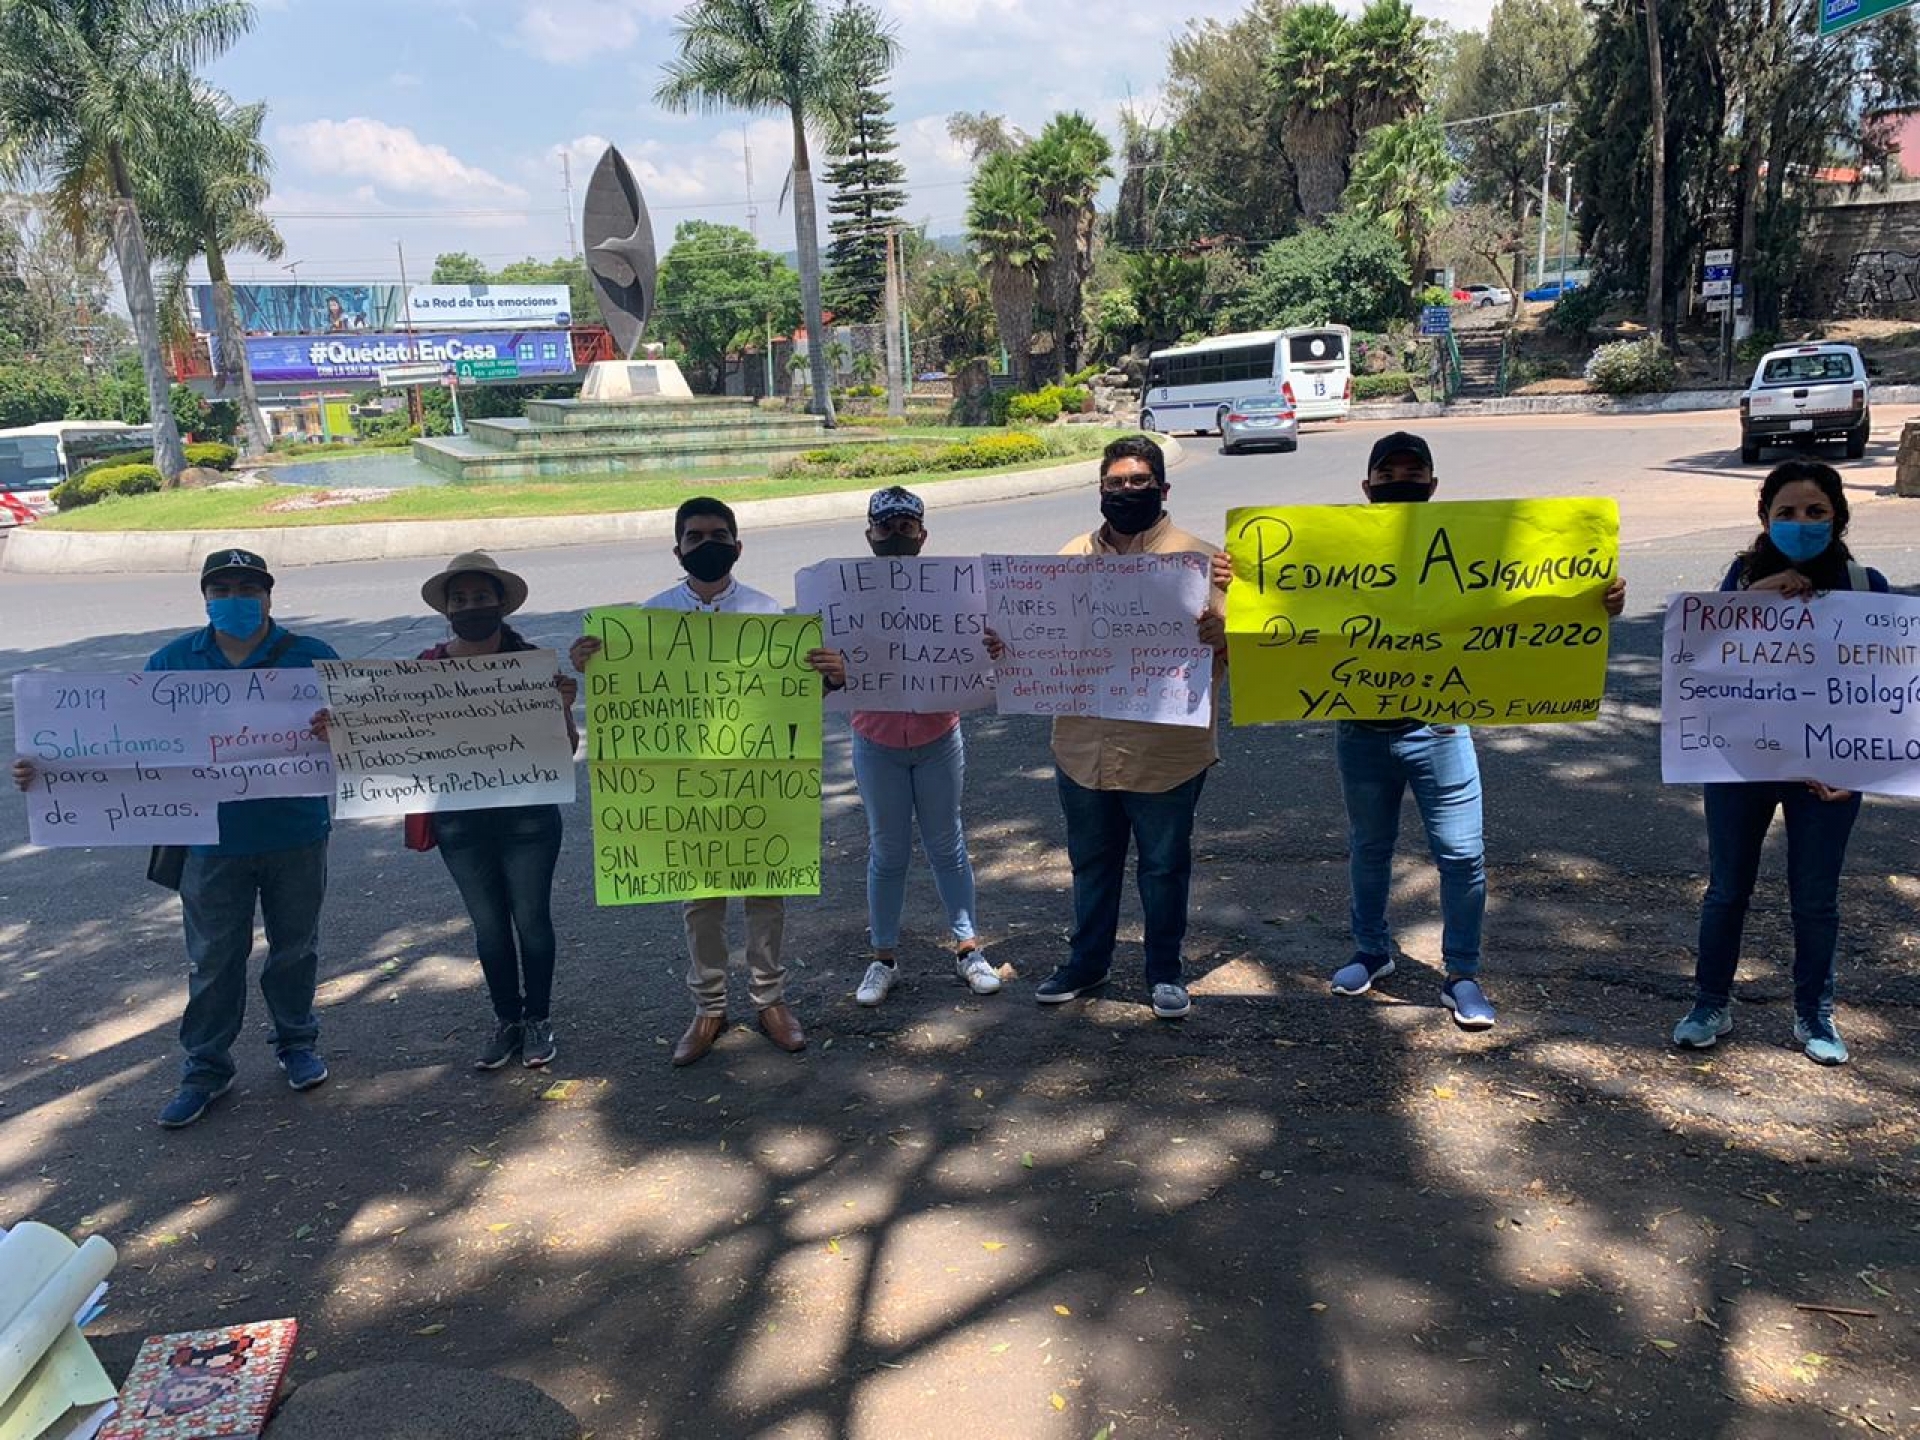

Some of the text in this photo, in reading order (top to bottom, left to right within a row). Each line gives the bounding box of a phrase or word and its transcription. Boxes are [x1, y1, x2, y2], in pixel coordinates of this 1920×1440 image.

[414, 297, 558, 308] La Red de tus emociones
[1313, 383, 1326, 397] 13
[1238, 515, 1613, 595] PEDIMOS ASIGNACIÓN
[989, 576, 1042, 591] sultado
[1072, 592, 1150, 617] MANUEL
[1682, 596, 1815, 633] PRÓRROGA
[1010, 617, 1186, 641] LÓPEZ OBRADOR
[1257, 615, 1321, 648] DE
[1463, 622, 1603, 652] 2019-2020
[889, 642, 974, 665] PLAZAS
[1003, 645, 1112, 660] Necesitamos
[1670, 639, 1696, 664] de
[1721, 642, 1816, 665] PLAZAS
[593, 671, 810, 696] DE LA LISTA DE
[995, 661, 1192, 684] para obtener plazas
[55, 689, 106, 710] 2019
[291, 684, 323, 701] 20
[1013, 681, 1095, 697] definitivas
[1110, 686, 1128, 696] en
[594, 698, 740, 724] ORDENAMIENTO
[1298, 689, 1356, 719] YA
[1377, 693, 1496, 720] FUIMOS
[33, 724, 313, 763] Solicitamos prórroga
[349, 728, 435, 745] Evaluados
[1679, 716, 1731, 751] Edo.
[1754, 721, 1783, 751] de
[42, 753, 330, 793] para la asignación
[597, 767, 822, 799] NOS ESTAMOS
[45, 801, 78, 825] de
[601, 805, 766, 834] QUEDANDO
[601, 834, 789, 872] SIN EMPLEO
[704, 872, 720, 889] DE
